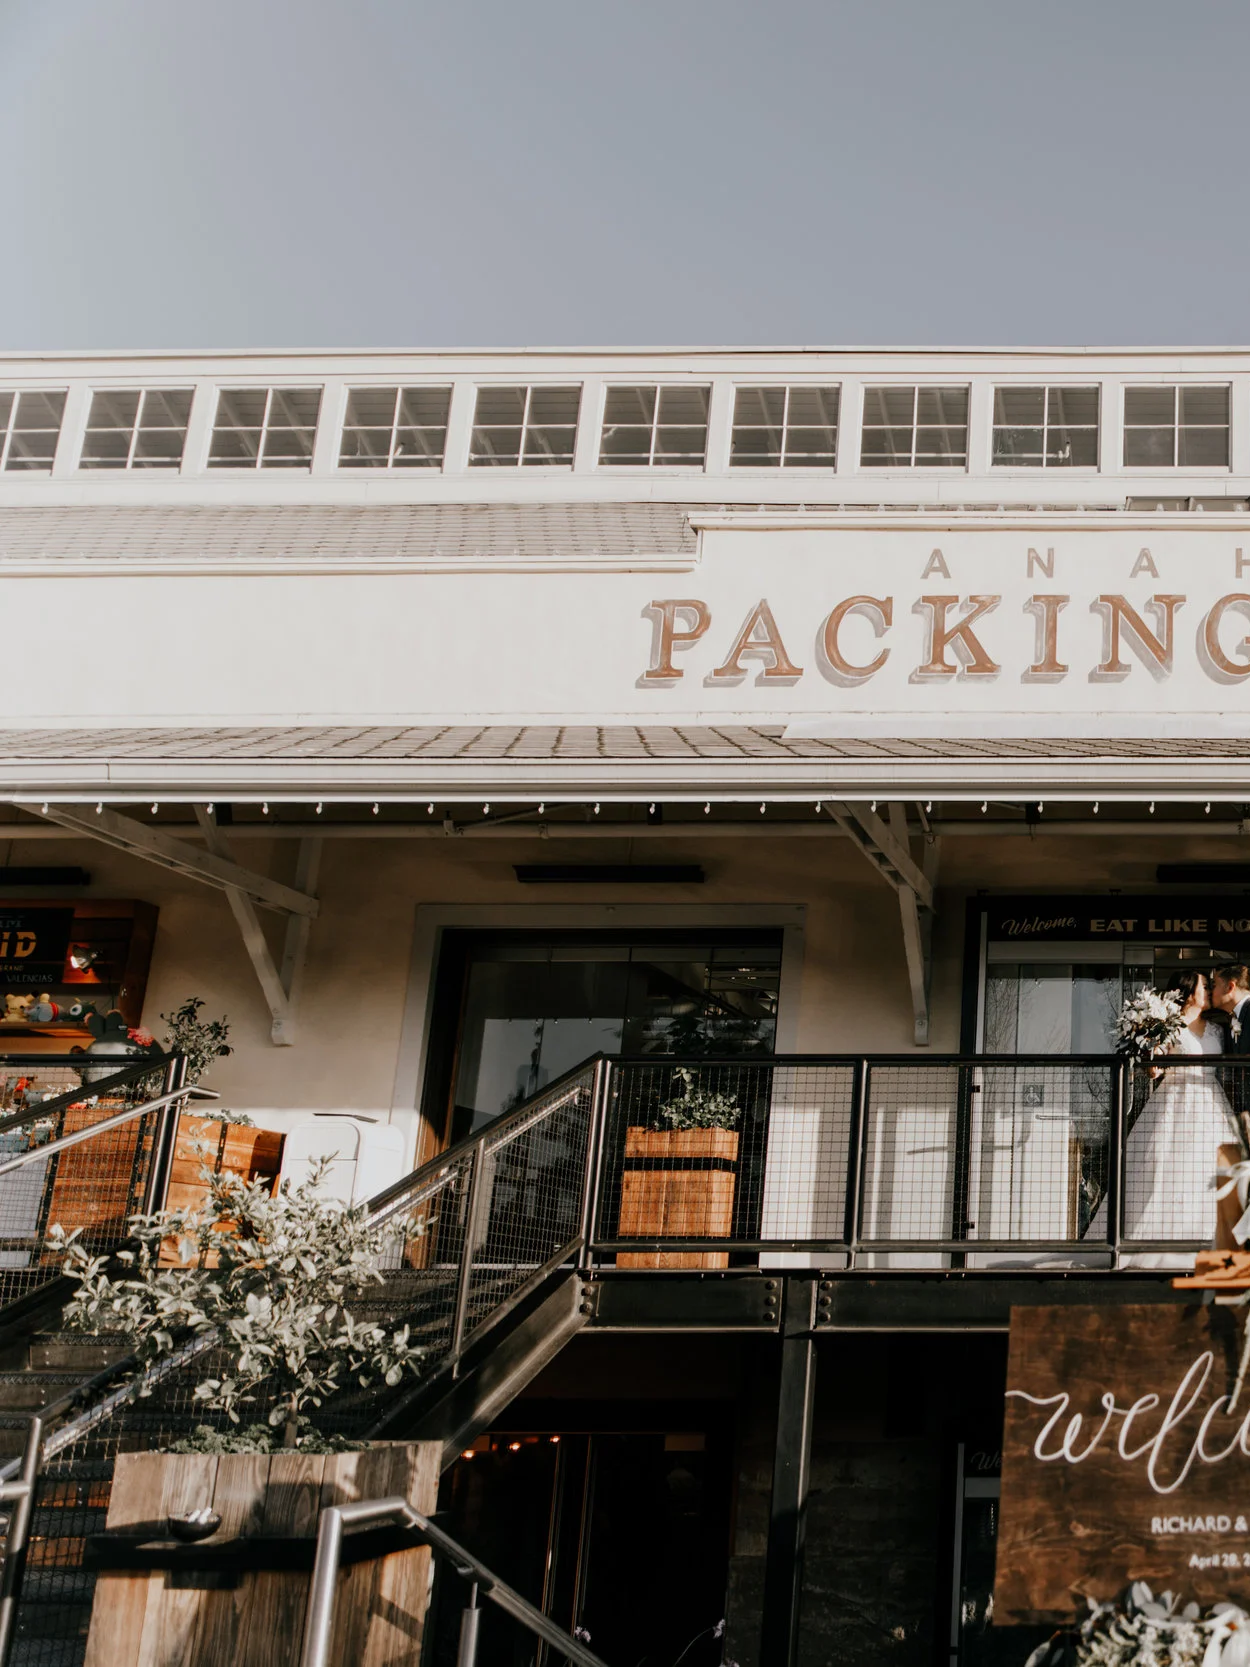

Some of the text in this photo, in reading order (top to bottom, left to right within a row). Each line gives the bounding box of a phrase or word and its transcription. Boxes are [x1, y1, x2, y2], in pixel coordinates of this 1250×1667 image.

[1090, 918, 1139, 933] EAT
[1147, 918, 1208, 933] LIKE
[7, 974, 54, 983] VALENCIAS
[1150, 1514, 1231, 1534] RICHARD
[1234, 1515, 1249, 1532] &
[1189, 1553, 1221, 1571] April
